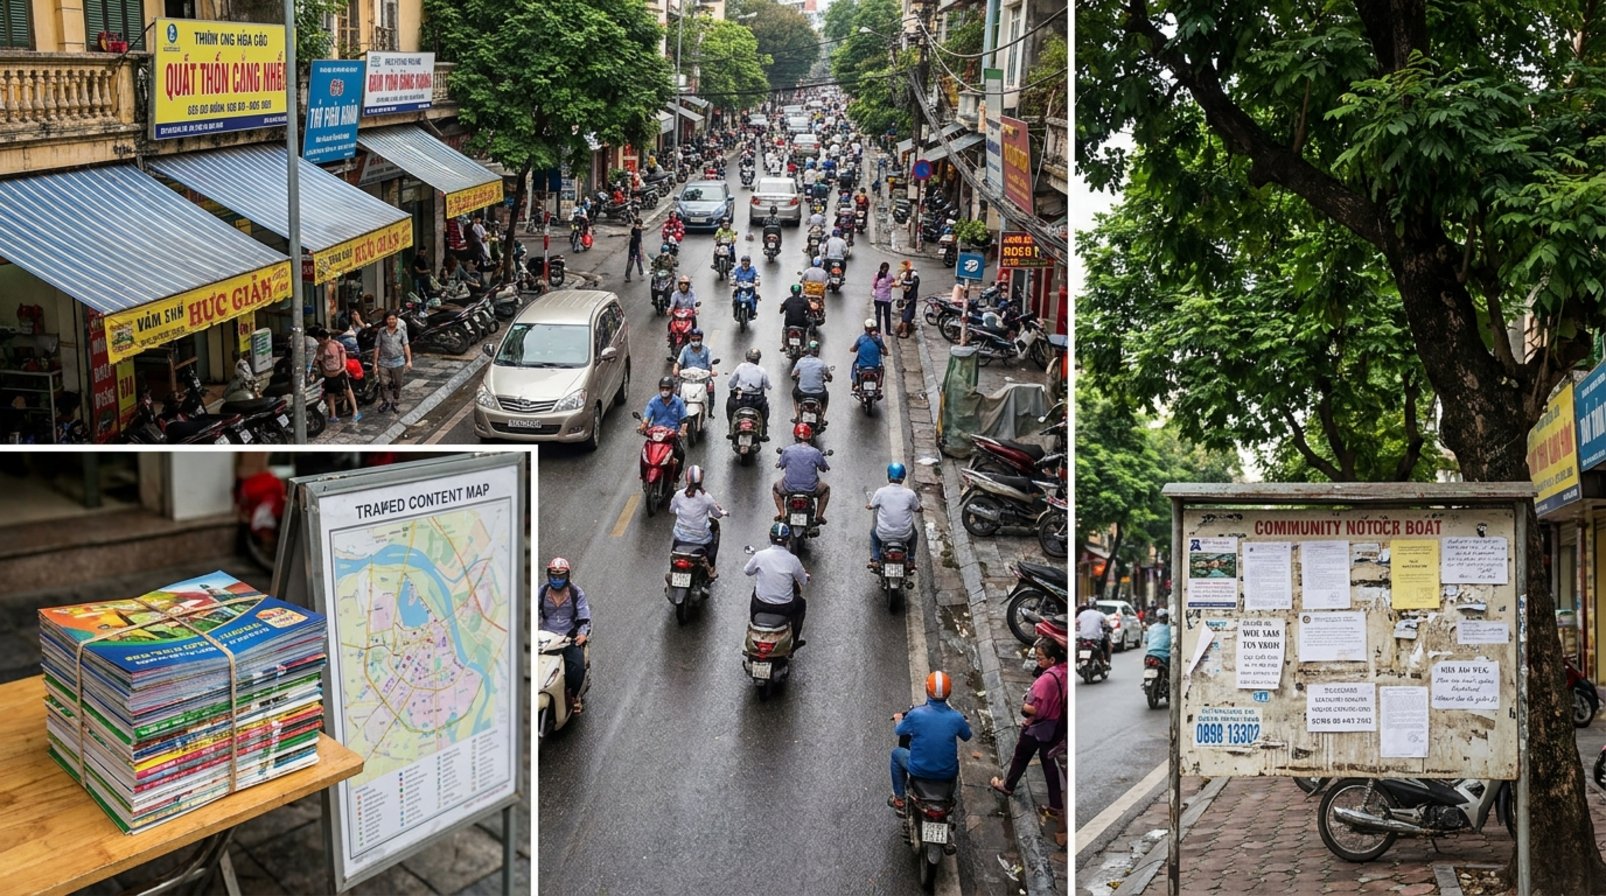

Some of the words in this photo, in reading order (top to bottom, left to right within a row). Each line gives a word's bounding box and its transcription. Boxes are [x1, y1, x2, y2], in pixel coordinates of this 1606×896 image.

[408, 487, 463, 510] CONTENT
[466, 483, 490, 499] MAP
[1254, 519, 1341, 535] COMMUNITY
[1405, 519, 1442, 535] BOAT
[1196, 723, 1223, 744] 0898
